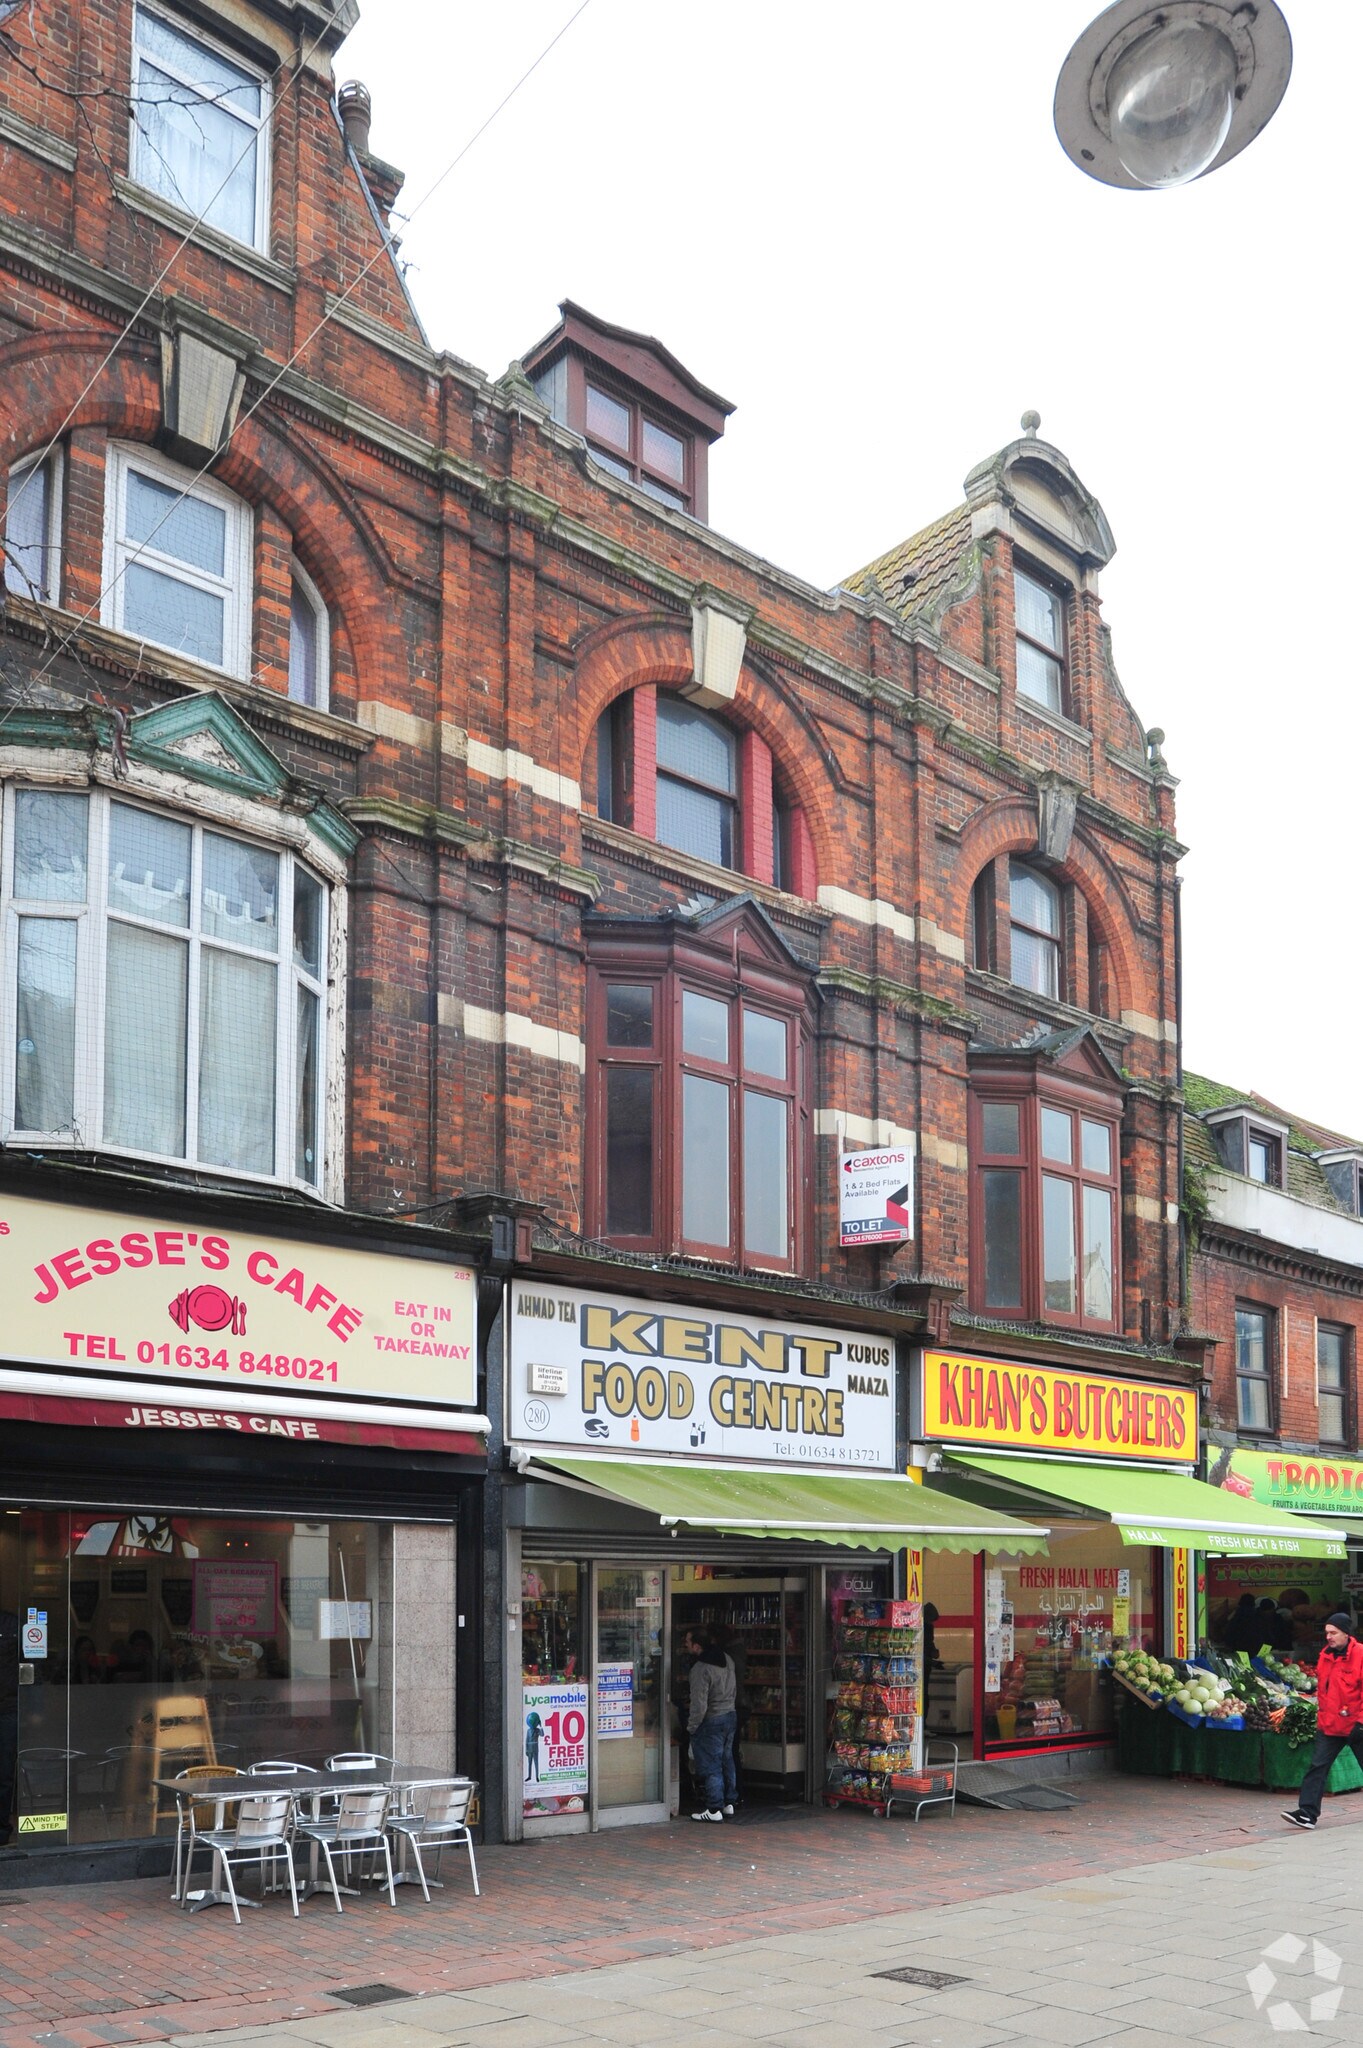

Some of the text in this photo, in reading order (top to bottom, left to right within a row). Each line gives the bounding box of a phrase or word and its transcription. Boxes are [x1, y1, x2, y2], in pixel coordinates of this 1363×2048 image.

[853, 1154, 905, 1168] caxtons
[845, 1189, 879, 1198] Available
[845, 1220, 883, 1233] TO LET
[34, 1232, 230, 1304] JESSE'S
[454, 1272, 470, 1280] 282
[394, 1301, 451, 1322] EAT IN
[517, 1294, 576, 1324] AHMAD TEA
[411, 1322, 435, 1338] OR
[374, 1336, 470, 1359] TAKEAWAY
[580, 1304, 842, 1378] KENT
[64, 1332, 338, 1382] TEL 01634 848021
[847, 1343, 890, 1367] KUBUS
[538, 1367, 562, 1375] lifeline
[848, 1374, 889, 1397] MAAZA
[582, 1359, 844, 1437] FOOD CENTRE
[940, 1362, 1185, 1449] KHAN'S BUTCHERS
[124, 1408, 320, 1439] JESSE'S CAFE
[528, 1407, 545, 1424] 280
[773, 1442, 880, 1461] Tel: 01634 813721
[1273, 1500, 1293, 1508] FRUITS
[1300, 1502, 1335, 1511] VEGETABLES
[1127, 1530, 1167, 1542] HALAL
[1208, 1536, 1300, 1552] FRESH MEAT & FISH
[1326, 1544, 1342, 1555] 278
[1020, 1567, 1054, 1588] FRESH
[1058, 1568, 1091, 1588] HALAL
[1094, 1568, 1119, 1588] MEAT
[524, 1692, 586, 1706] Lycamobile
[544, 1710, 585, 1745] £10
[549, 1745, 584, 1758] FREE
[549, 1757, 584, 1768] CREDIT
